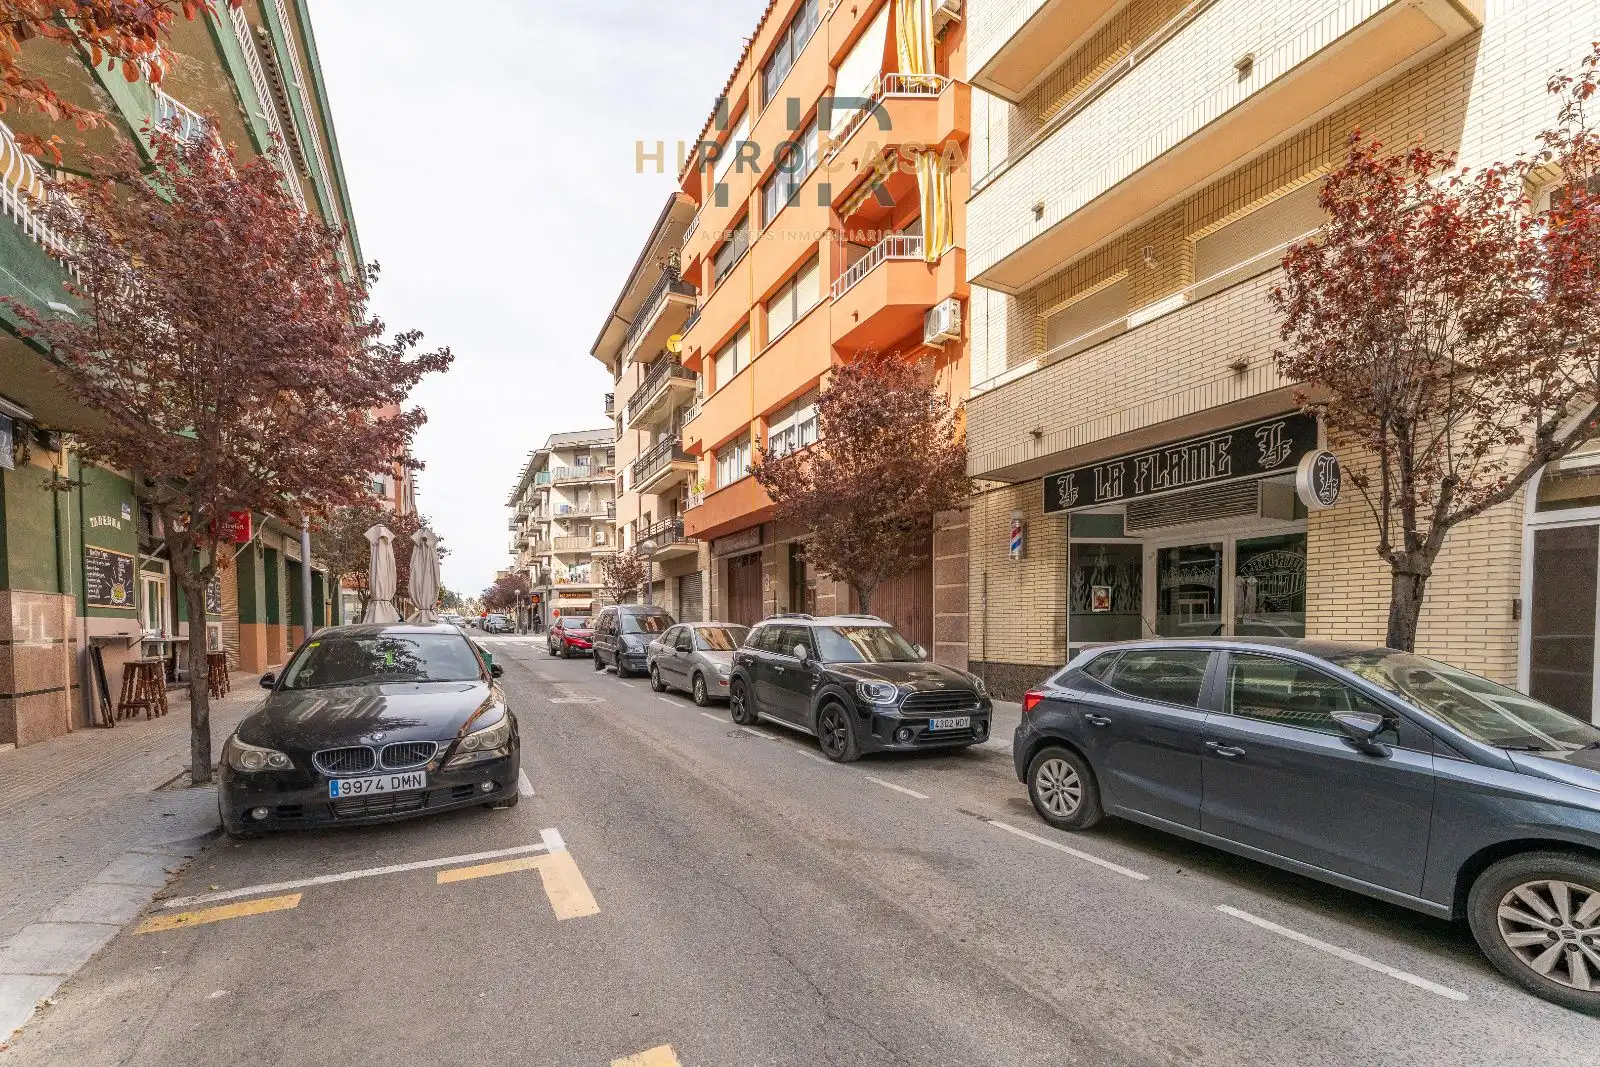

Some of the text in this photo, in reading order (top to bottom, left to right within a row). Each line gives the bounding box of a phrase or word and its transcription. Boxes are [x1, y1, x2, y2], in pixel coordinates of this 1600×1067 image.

[1094, 435, 1233, 501] LA FLAME
[935, 719, 954, 728] 4302
[342, 774, 422, 794] 9974 DMN
